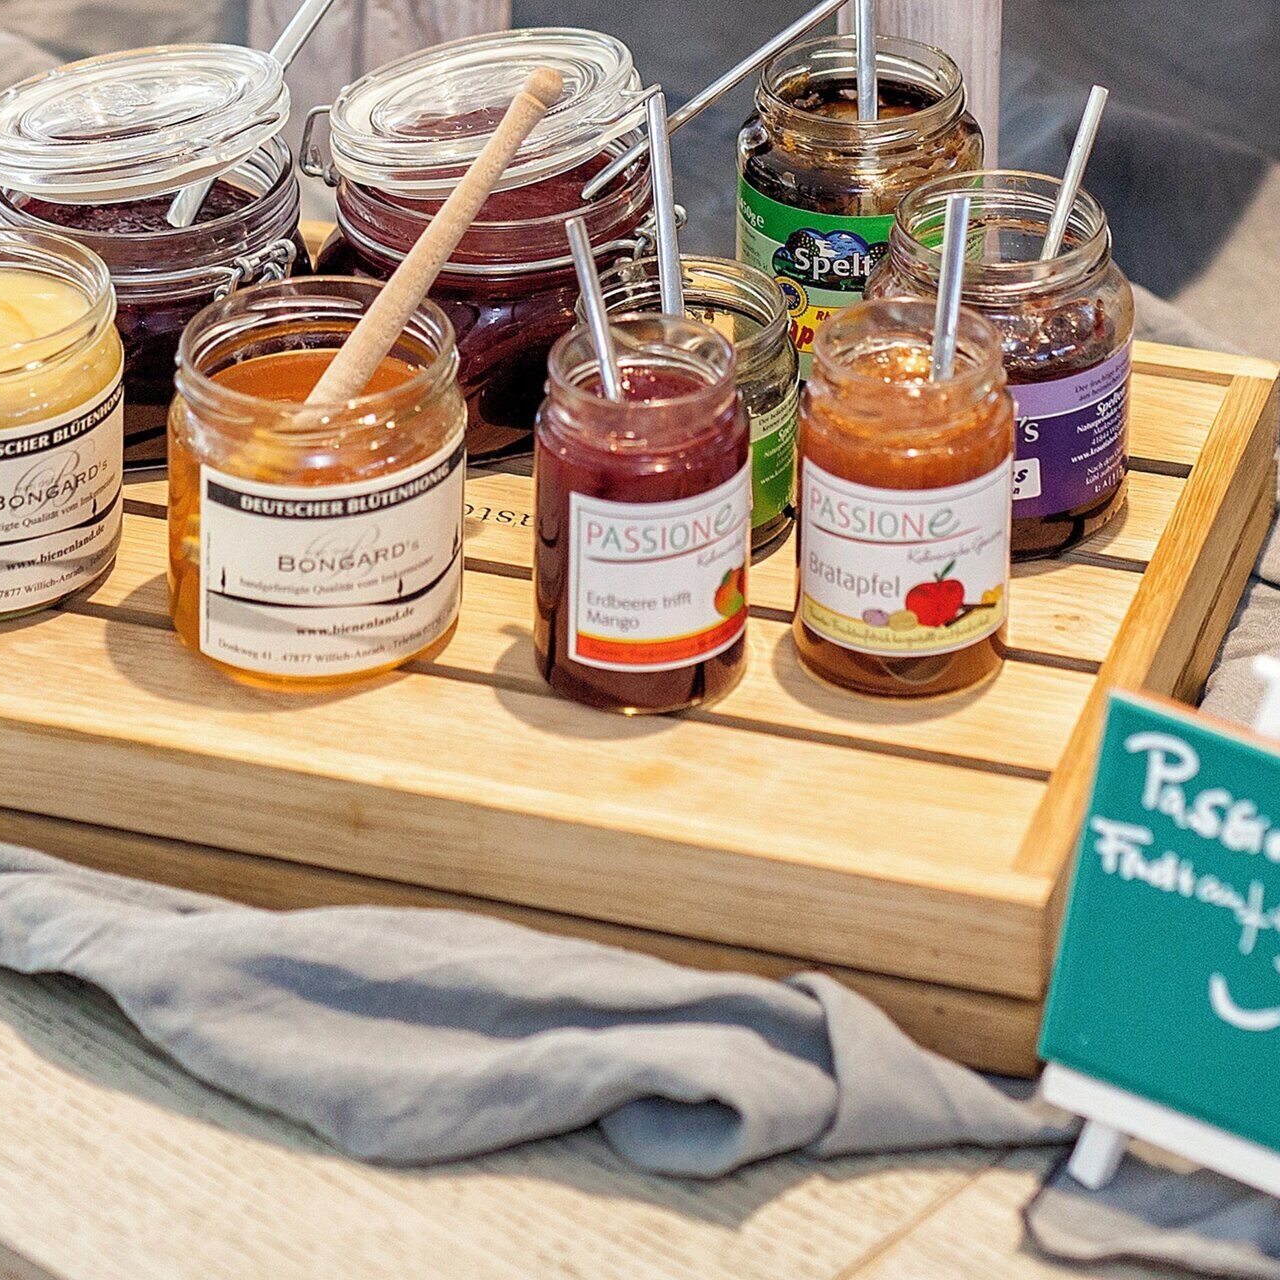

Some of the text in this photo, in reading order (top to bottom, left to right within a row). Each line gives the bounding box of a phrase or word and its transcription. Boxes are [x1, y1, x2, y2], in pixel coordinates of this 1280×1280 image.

[53, 382, 123, 444] BLÜTENHON
[240, 463, 452, 518] DEUTSCHER BLÜTENHONIG
[22, 510, 59, 527] Qualität
[6, 524, 105, 571] www.bienenland.de
[809, 552, 900, 598] Bratapfel
[586, 591, 657, 611] Erdbeere
[296, 606, 415, 637] www.bienenland.de
[587, 610, 640, 632] Mango
